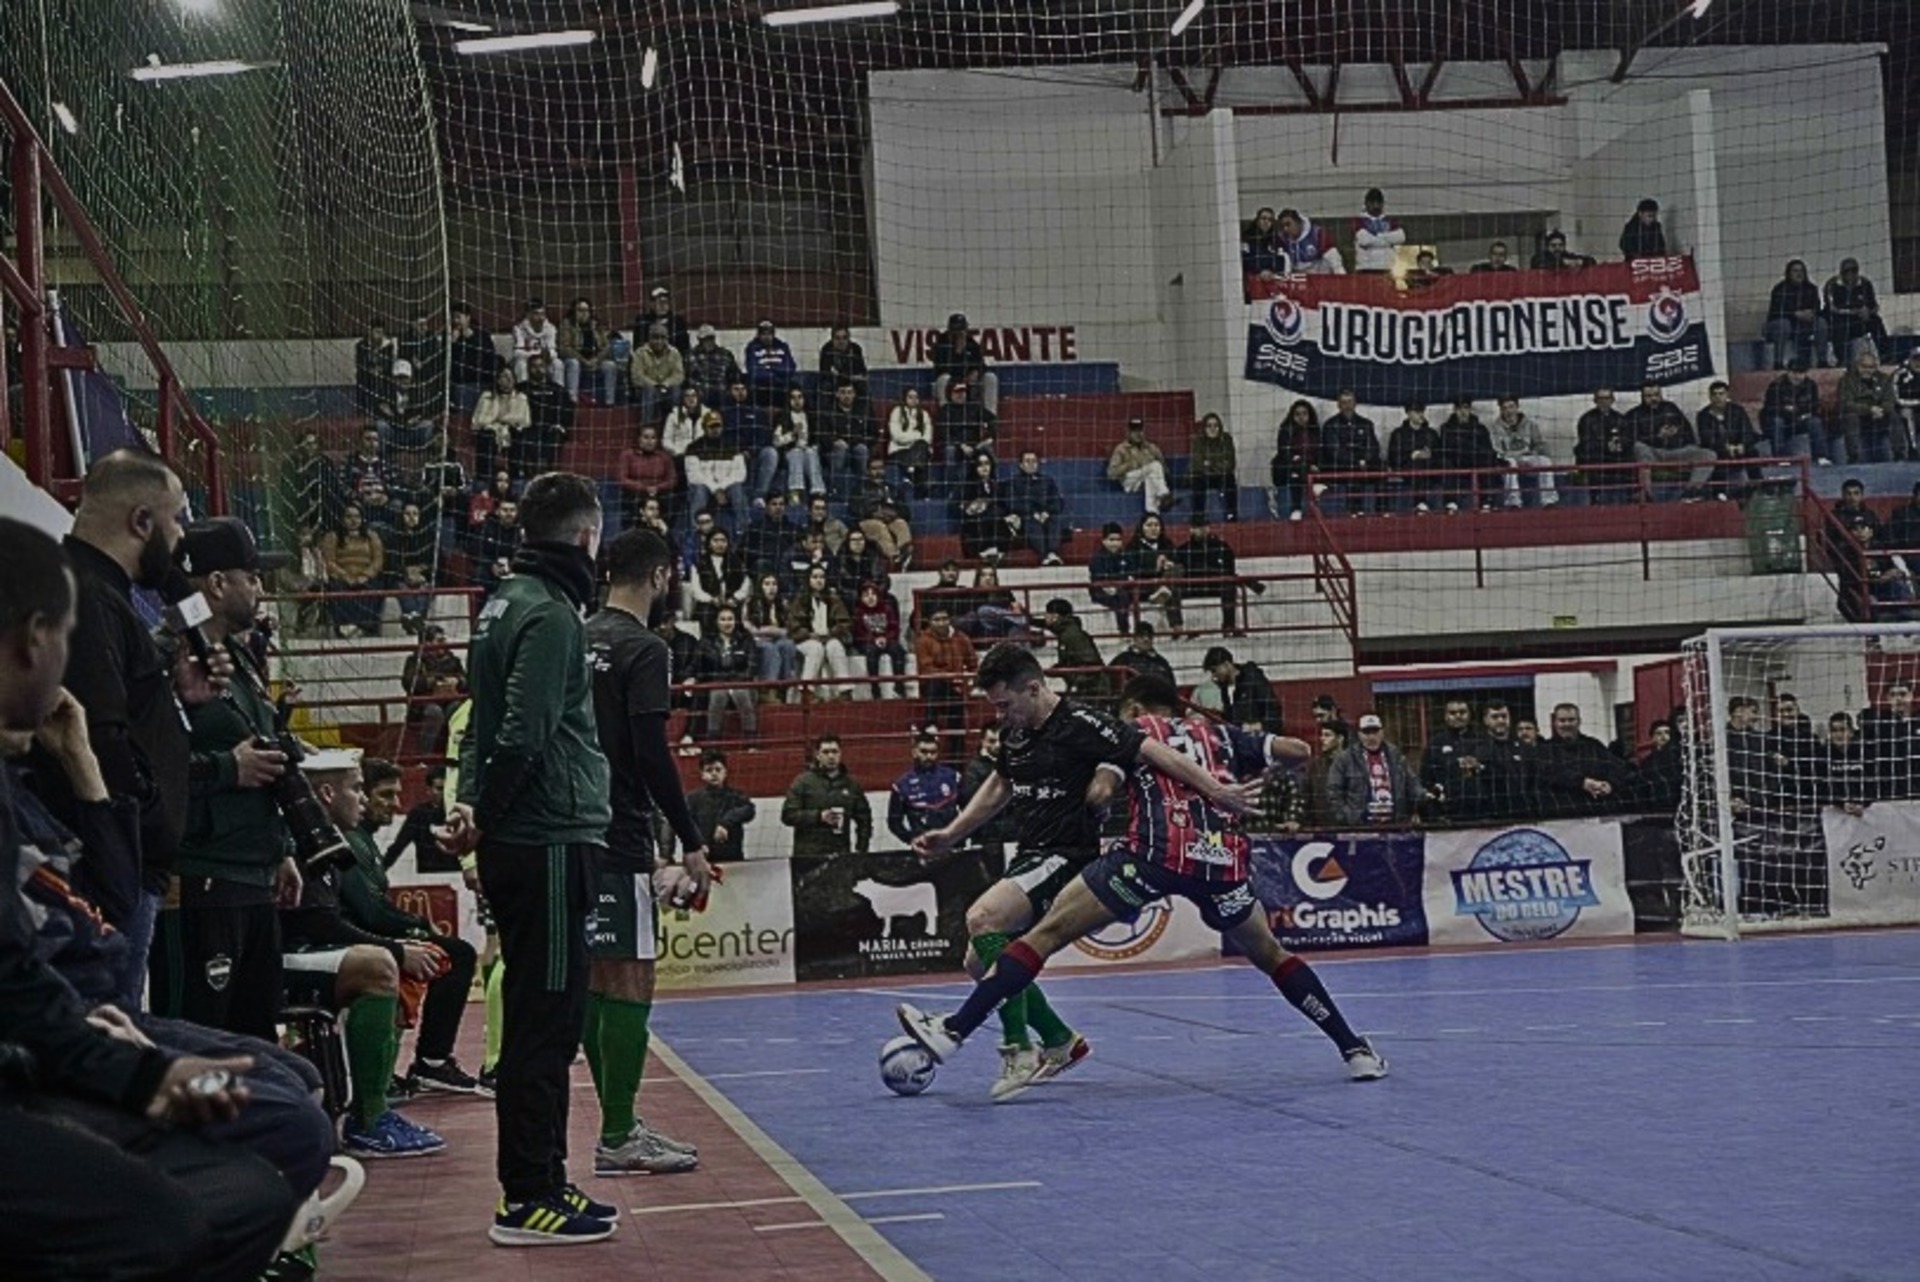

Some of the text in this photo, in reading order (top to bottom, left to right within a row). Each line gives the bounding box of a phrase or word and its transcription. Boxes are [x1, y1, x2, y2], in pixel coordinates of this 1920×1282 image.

[891, 326, 1077, 364] VISANTE
[1320, 297, 1632, 361] URUGUAIANENSE
[1461, 865, 1587, 904] MESTRE
[859, 938, 908, 953] MARIA
